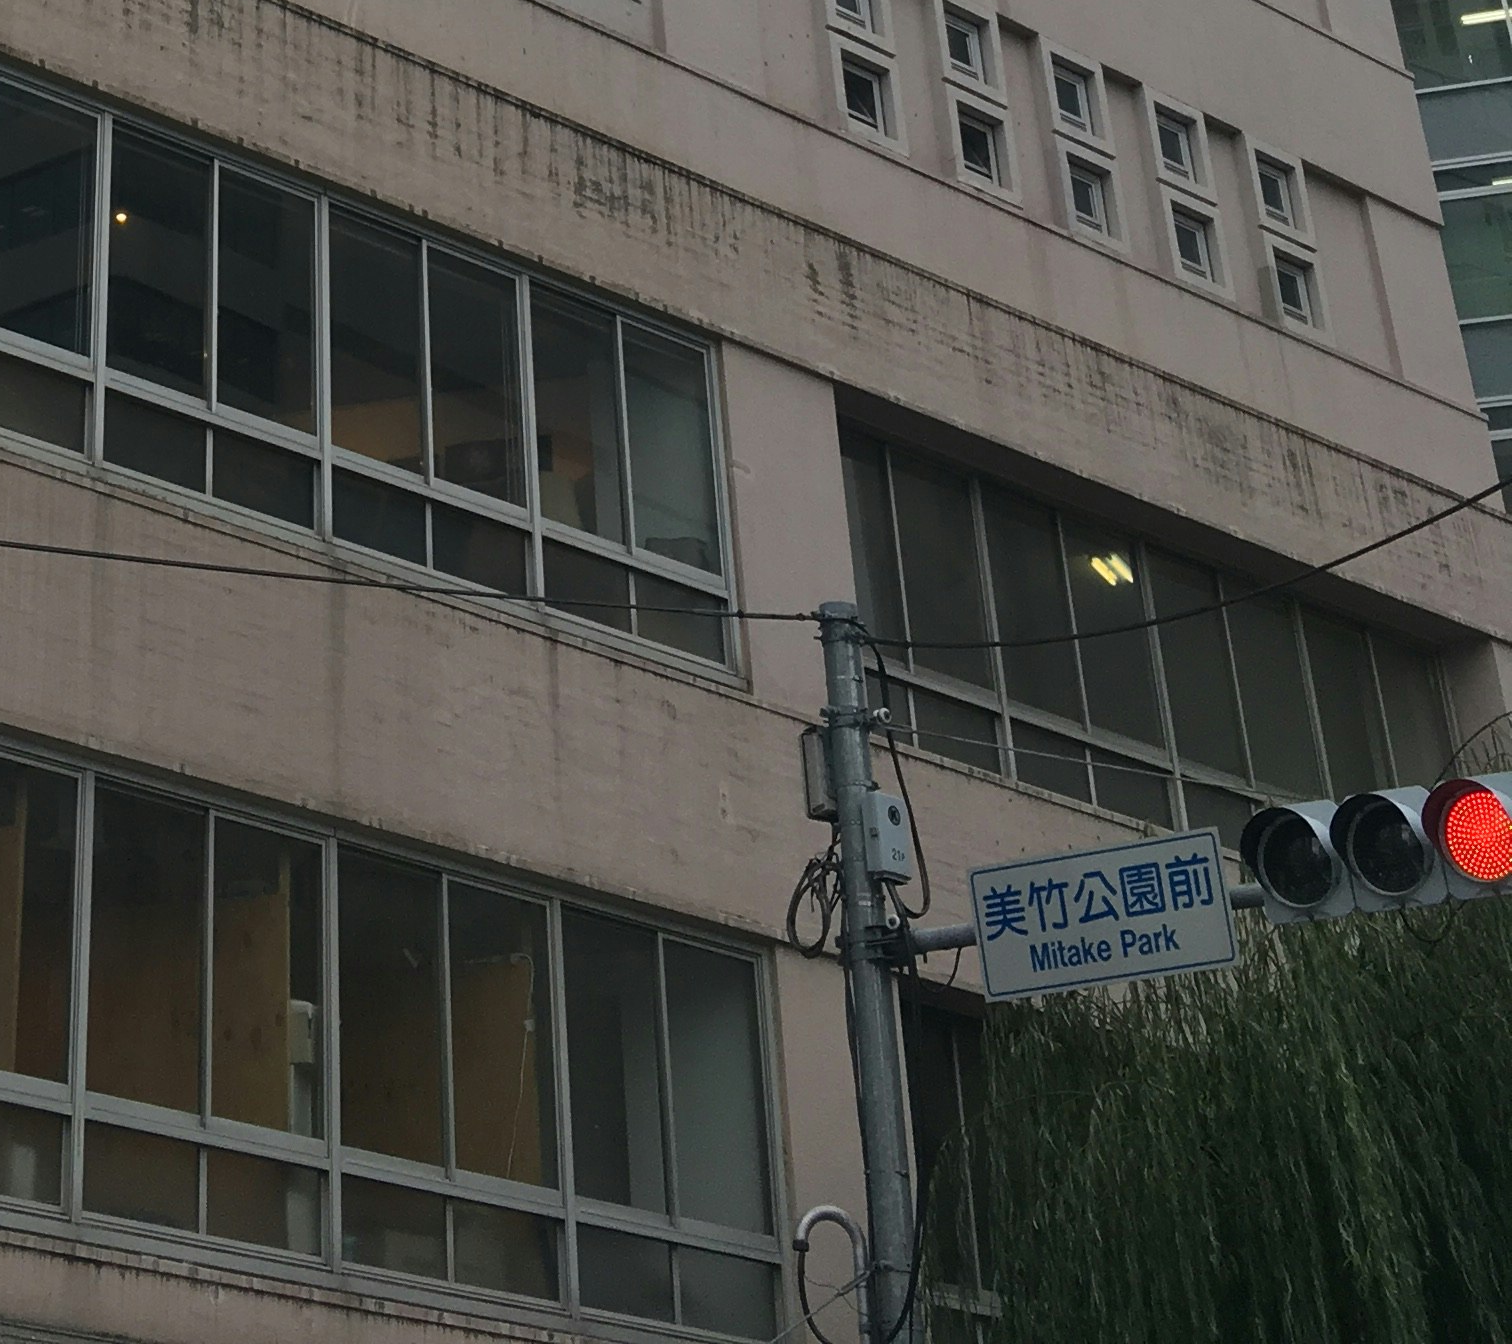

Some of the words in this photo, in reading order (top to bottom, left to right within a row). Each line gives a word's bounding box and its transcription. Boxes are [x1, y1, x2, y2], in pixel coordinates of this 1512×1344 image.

[982, 852, 1214, 942] 美竹公園前
[1029, 936, 1113, 973] Mitake
[1119, 923, 1181, 958] Park
